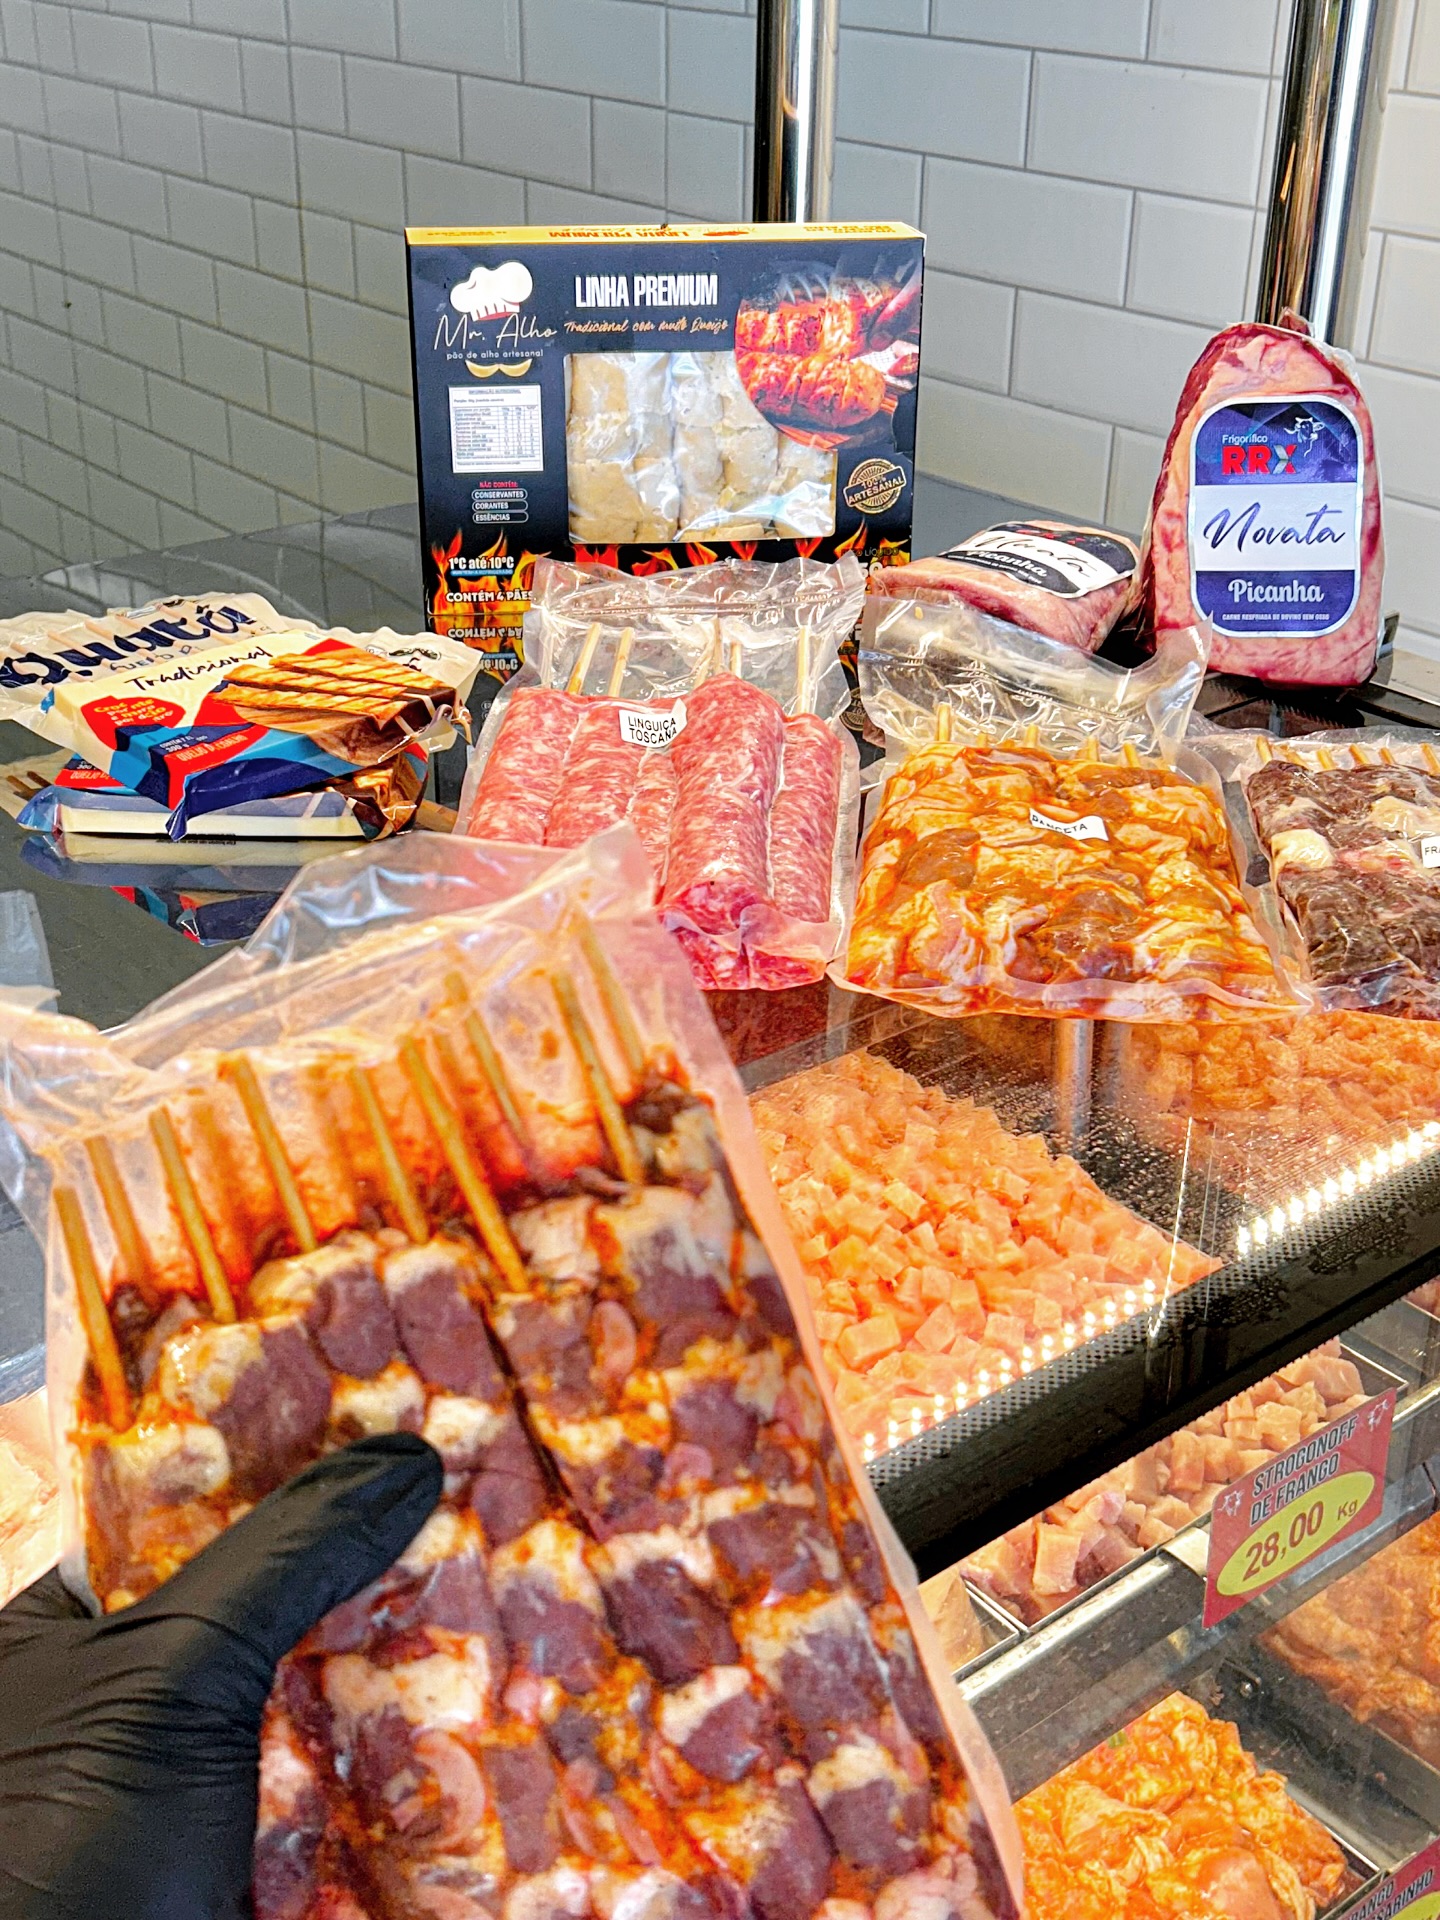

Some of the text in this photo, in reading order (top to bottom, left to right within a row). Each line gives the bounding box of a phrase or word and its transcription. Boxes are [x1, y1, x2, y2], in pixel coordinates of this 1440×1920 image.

[575, 273, 718, 308] LINHA PREMIUM
[434, 313, 557, 350] Mr. Alho
[564, 319, 629, 334] Tradicional
[632, 321, 655, 332] com
[447, 349, 544, 360] pão de alho artesanal
[1222, 445, 1297, 475] RRX
[474, 491, 524, 499] CONSERVANTES
[848, 476, 905, 504] ARTESANAL
[475, 502, 509, 510] CORANTES
[475, 512, 510, 521] ESSÊNCIAS
[1203, 502, 1346, 552] Novata
[469, 556, 487, 570] até
[446, 590, 494, 602] CONTÉM
[497, 591, 504, 601] 4
[1228, 579, 1324, 603] Picanha
[124, 646, 274, 691] Tradicional
[628, 716, 676, 731] LINGUIÇA
[629, 727, 678, 744] TOSCANA
[1424, 845, 1440, 855] FR
[1252, 1414, 1358, 1497] STROGONOFF
[1251, 1452, 1339, 1527] DE FRANGO
[1243, 1499, 1358, 1582] 28,00 Kg
